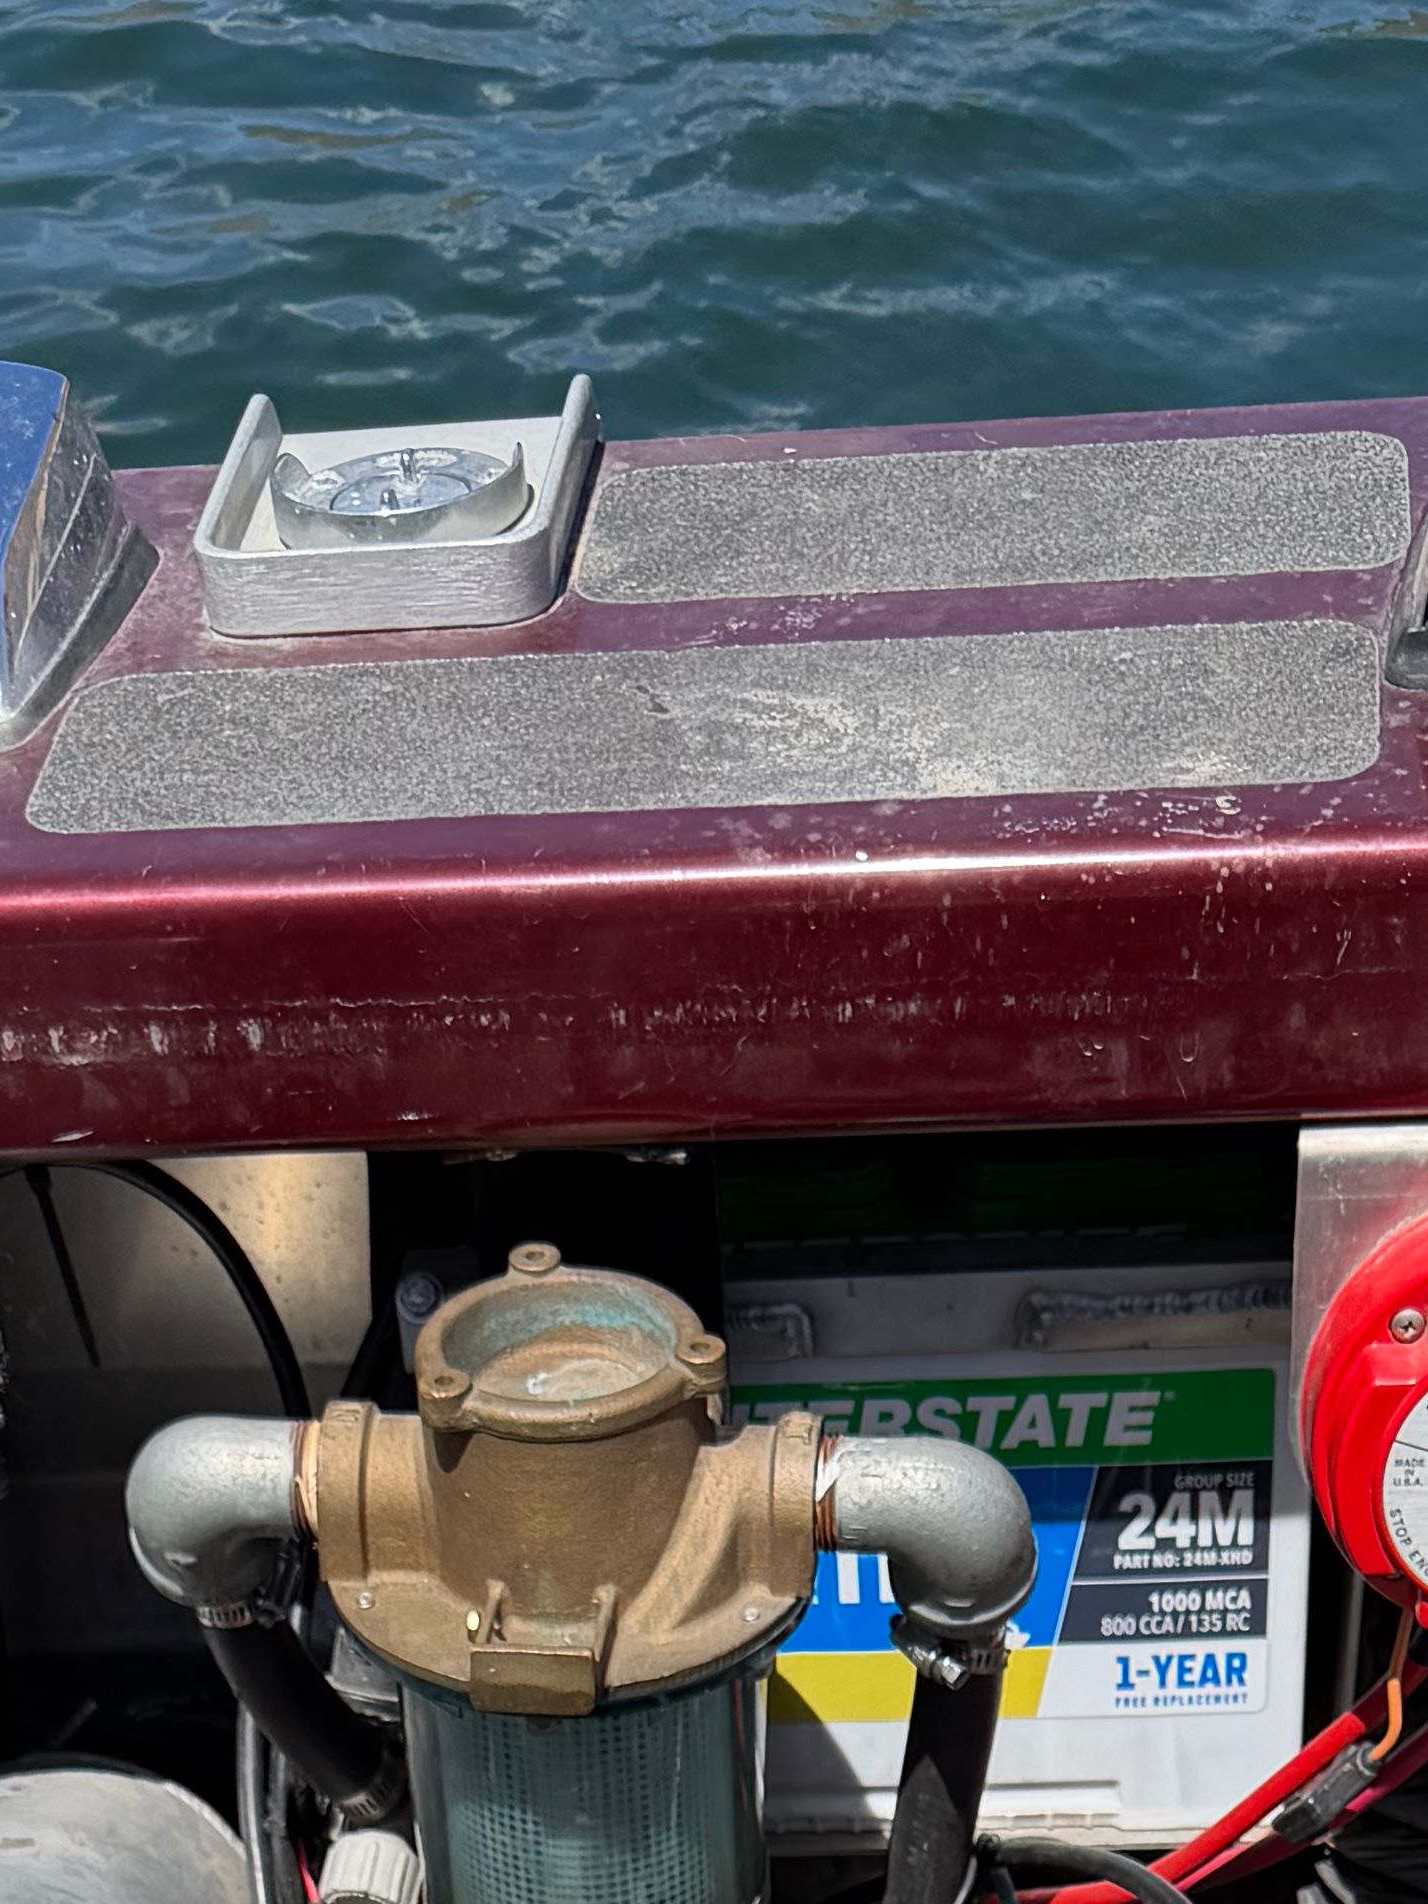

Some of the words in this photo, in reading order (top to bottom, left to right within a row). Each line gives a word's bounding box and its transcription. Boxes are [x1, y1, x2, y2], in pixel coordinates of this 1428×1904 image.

[730, 1391, 1162, 1450] ERSTATE
[1394, 1459, 1426, 1468] MADE
[1404, 1468, 1416, 1476] IN
[1174, 1473, 1223, 1489] GROUP
[1226, 1471, 1255, 1487] SIZE
[1117, 1490, 1255, 1550] 24M
[1388, 1508, 1411, 1550] STOP
[1113, 1554, 1151, 1570] PART
[1152, 1552, 1181, 1569] NO:
[1148, 1590, 1201, 1613] 1000
[1204, 1588, 1252, 1611] MCA
[1100, 1614, 1137, 1637] 800
[1138, 1613, 1175, 1635] CCA
[1188, 1613, 1222, 1634] 135
[1225, 1611, 1252, 1632] RC
[1114, 1652, 1249, 1691] 1-YEAR
[1115, 1696, 1147, 1709] FREE
[1153, 1693, 1249, 1708] REPLACEMENT
